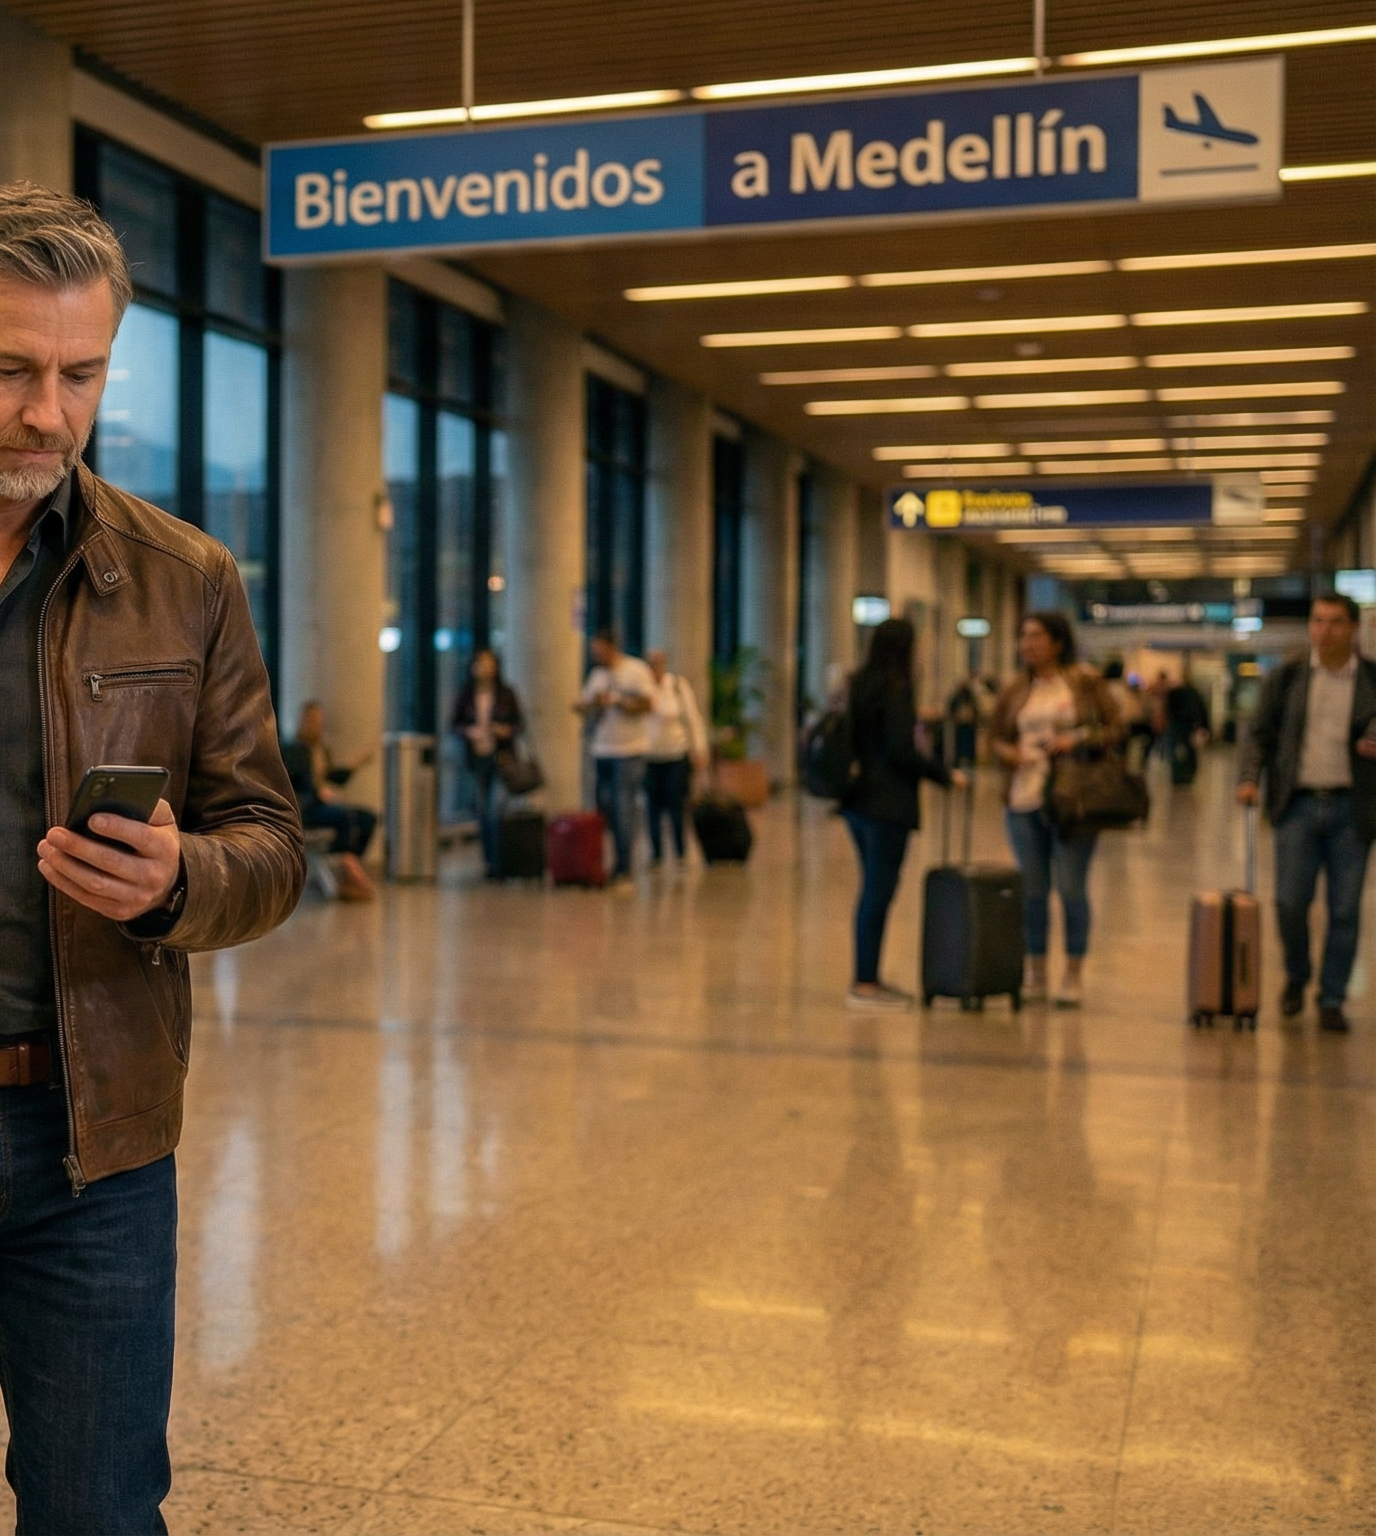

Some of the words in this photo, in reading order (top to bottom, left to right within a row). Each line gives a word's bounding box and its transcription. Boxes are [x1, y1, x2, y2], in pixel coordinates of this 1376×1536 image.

[294, 148, 665, 230] Bienvenidos
[730, 149, 770, 200] a
[788, 108, 1108, 195] Medellín
